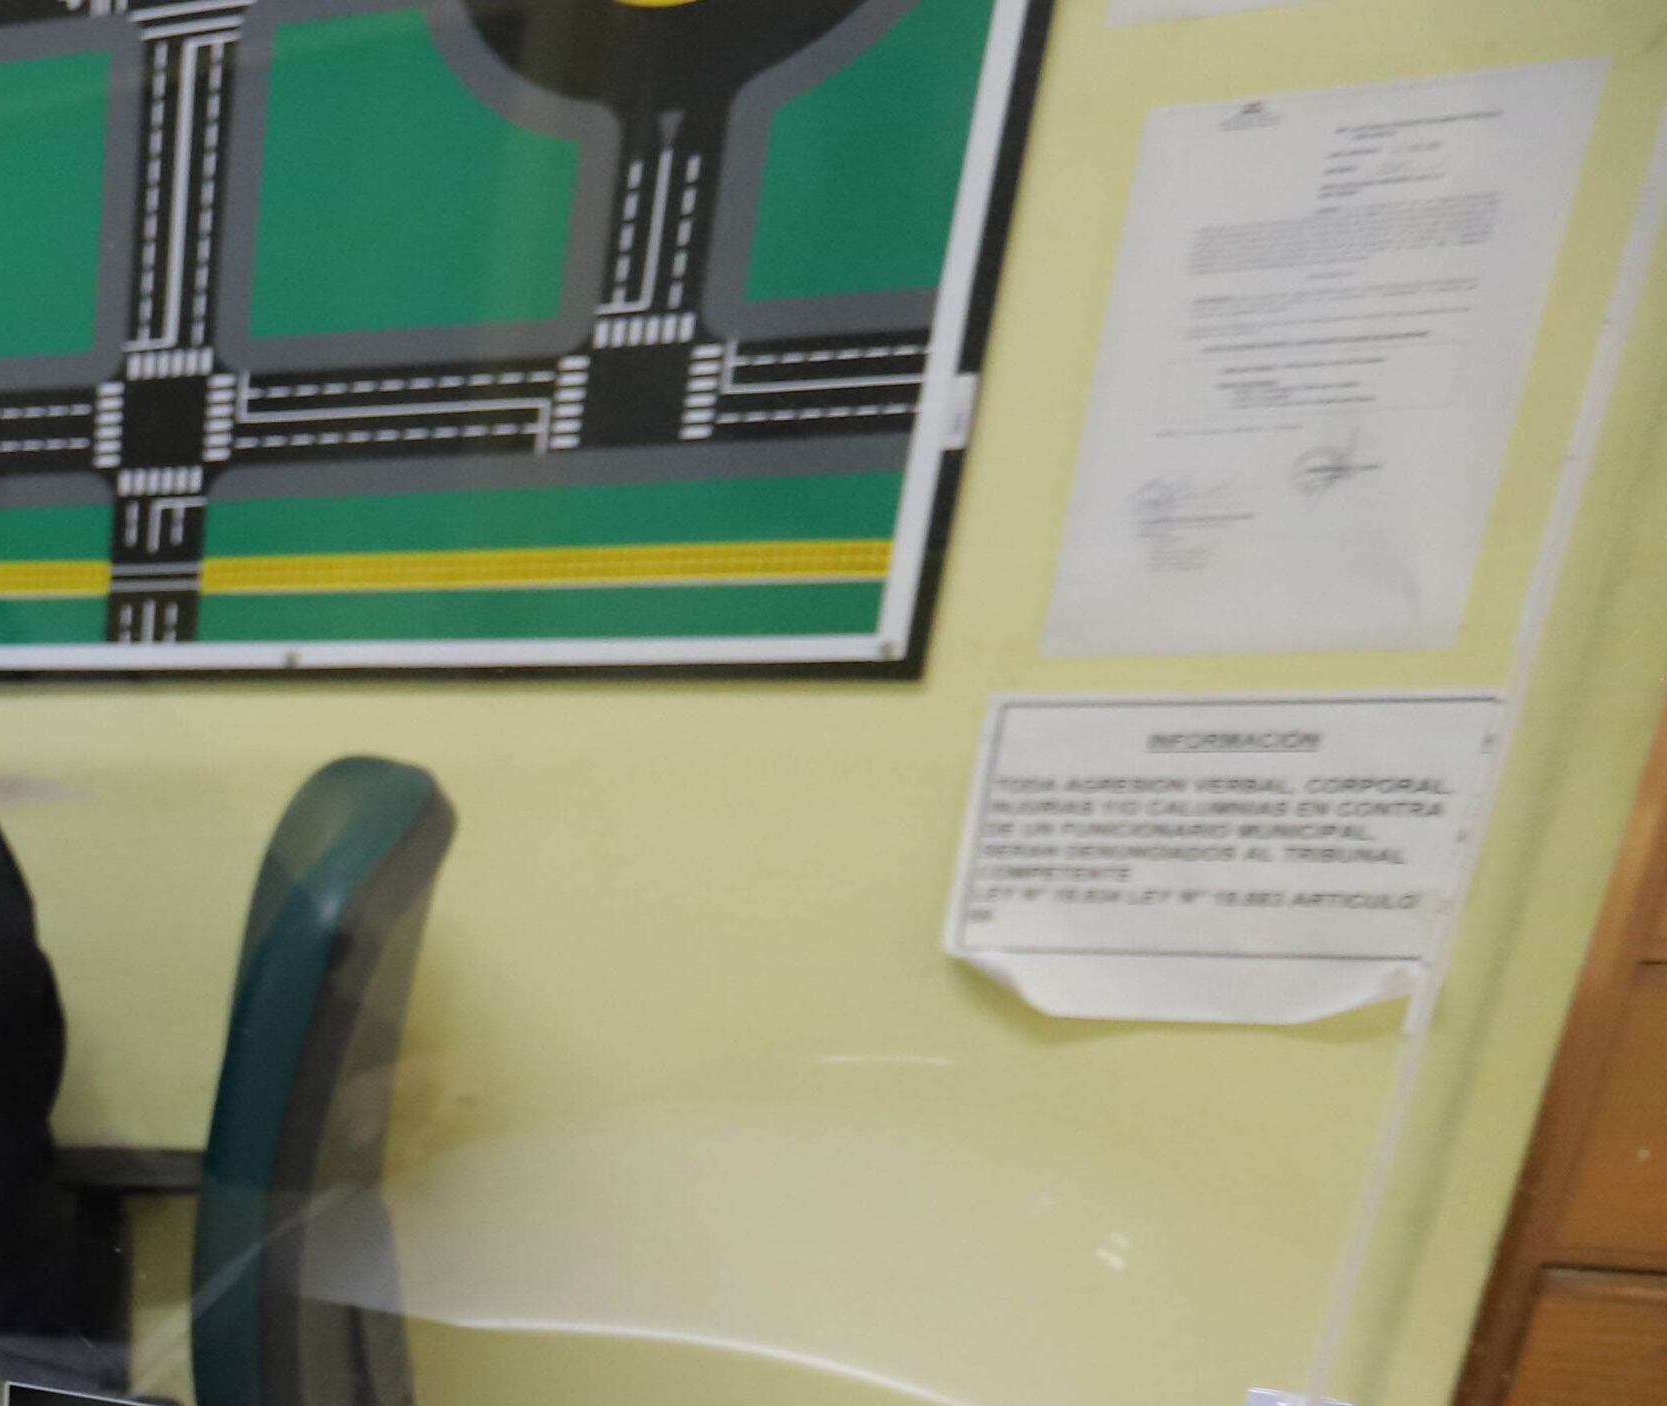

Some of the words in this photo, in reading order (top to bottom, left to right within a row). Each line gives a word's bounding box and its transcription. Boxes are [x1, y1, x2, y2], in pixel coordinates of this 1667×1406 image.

[1296, 801, 1330, 817] EN
[1337, 801, 1445, 818] CONTRA
[1284, 847, 1406, 864] TRIBUNAL
